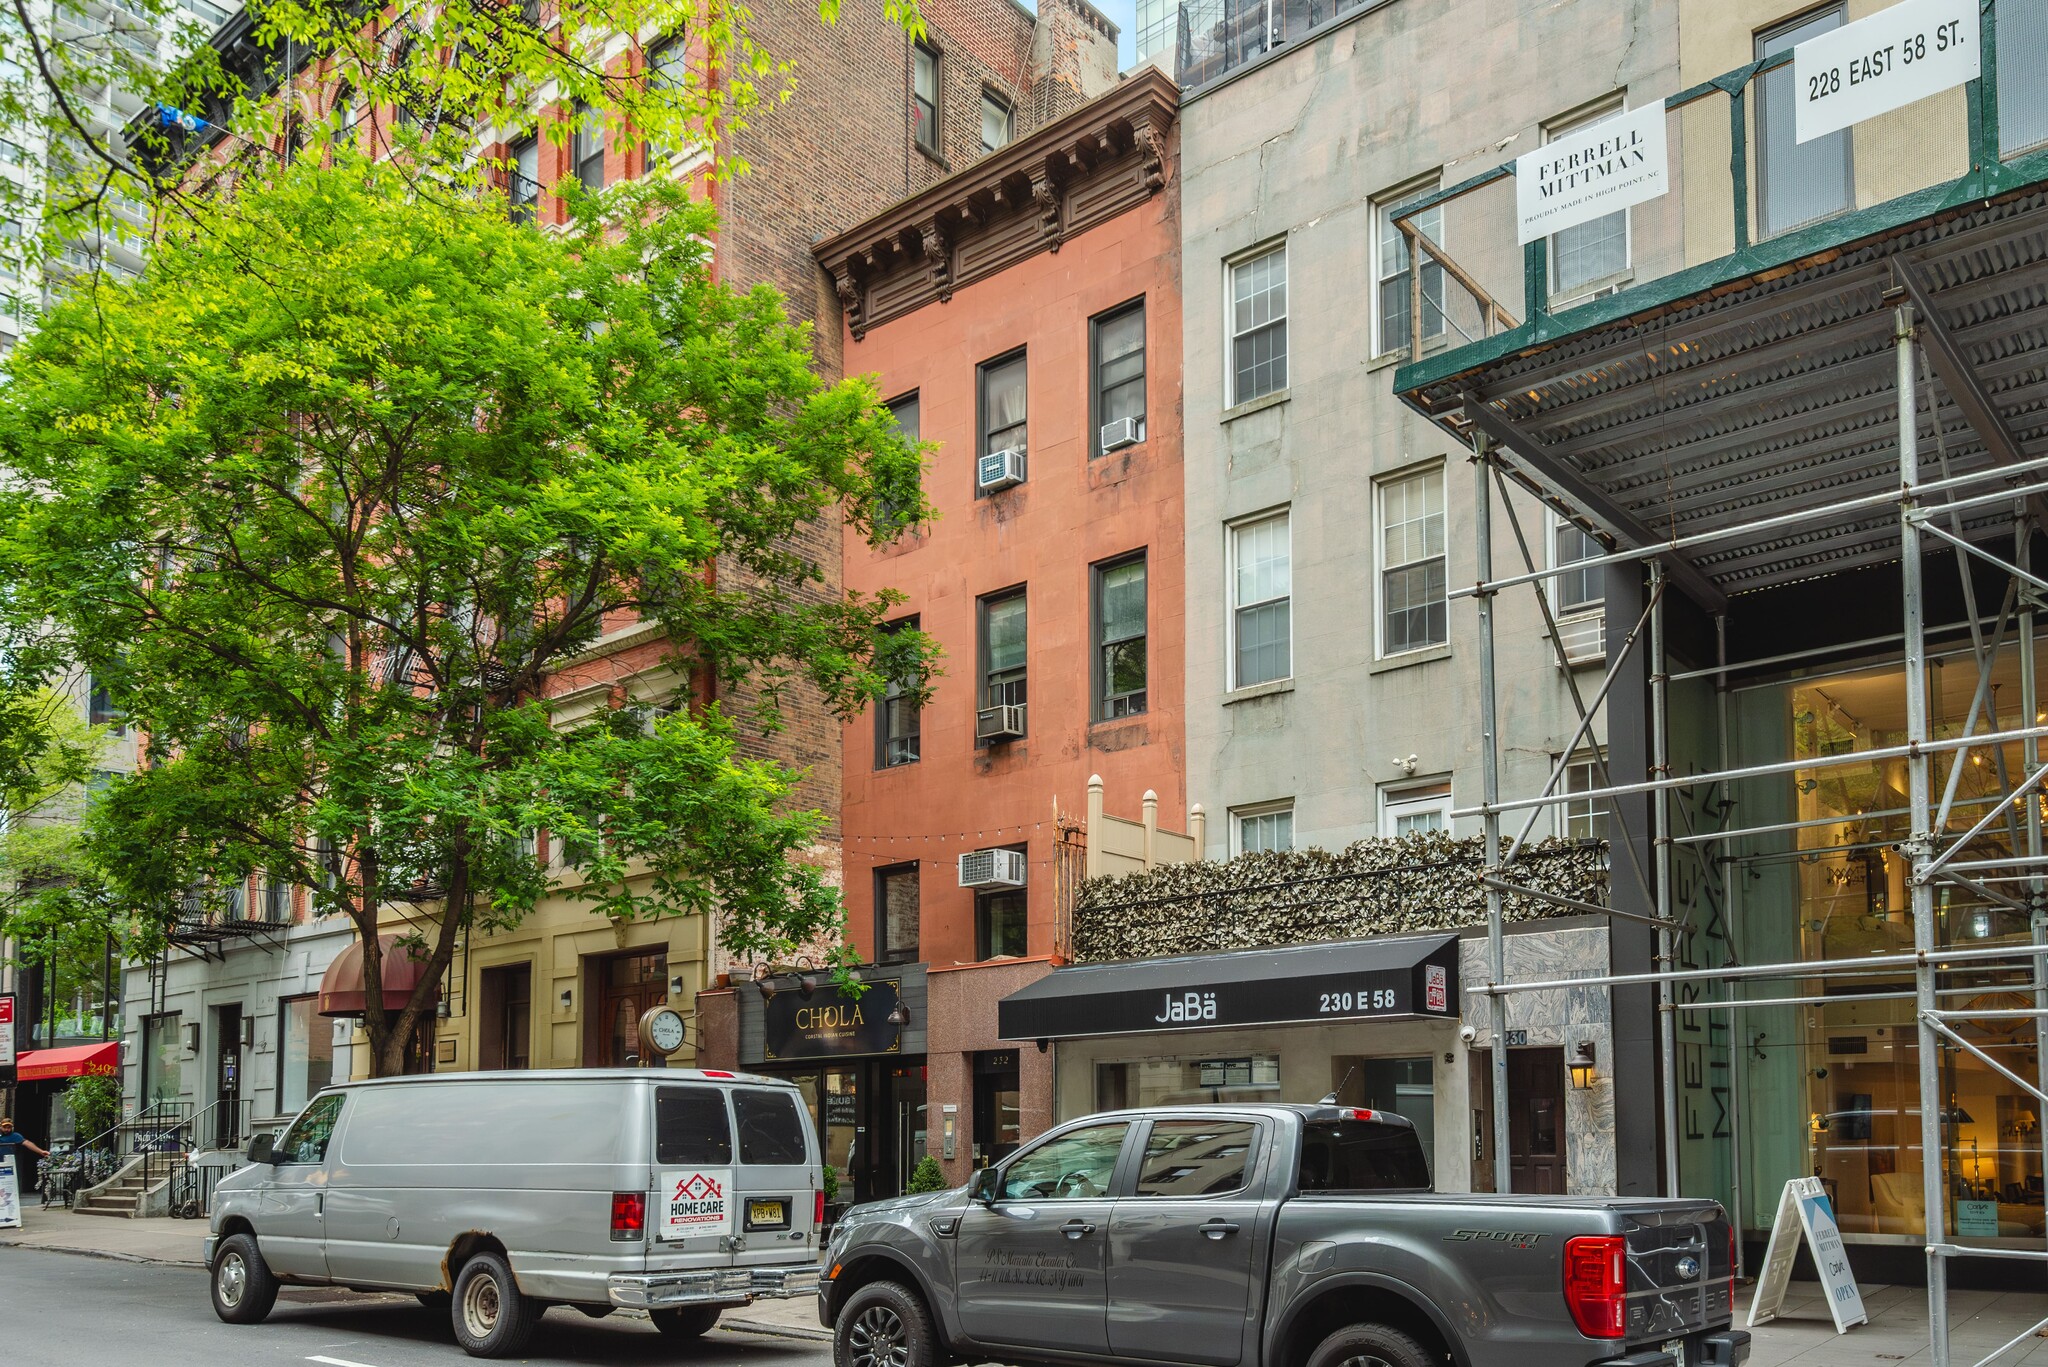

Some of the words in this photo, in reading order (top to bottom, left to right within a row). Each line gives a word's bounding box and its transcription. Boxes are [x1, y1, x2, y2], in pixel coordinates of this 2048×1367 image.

[1808, 67, 1840, 102] 228
[1849, 45, 1894, 86] EAST
[1903, 33, 1926, 65] 58
[1937, 19, 1965, 51] ST.
[1538, 129, 1643, 181] FERRELL
[1538, 147, 1646, 201] MITTMAN
[1524, 206, 1559, 224] PROUDLY
[1560, 198, 1583, 210] MADE
[1584, 193, 1594, 203] IN
[1595, 186, 1617, 199] HIGH
[1648, 169, 1660, 180] NC
[1155, 992, 1217, 1023] JaBä
[1319, 992, 1352, 1012] 230
[1357, 991, 1368, 1010] E
[1372, 989, 1395, 1009] 58
[795, 1004, 865, 1030] CHOLA
[804, 1032, 822, 1040] COASTAL
[823, 1031, 838, 1039] INDIAN
[838, 1030, 856, 1038] CUISINE
[670, 1202, 698, 1216] HOME
[700, 1201, 724, 1213] CARE
[674, 1215, 720, 1223] RENOVATIONS
[1442, 1228, 1553, 1243] SPORT
[1815, 1227, 1838, 1241] FERRELL
[1819, 1239, 1841, 1253] MITTMAN
[1035, 1249, 1064, 1268] Elevator
[1835, 1283, 1856, 1302] OPEN
